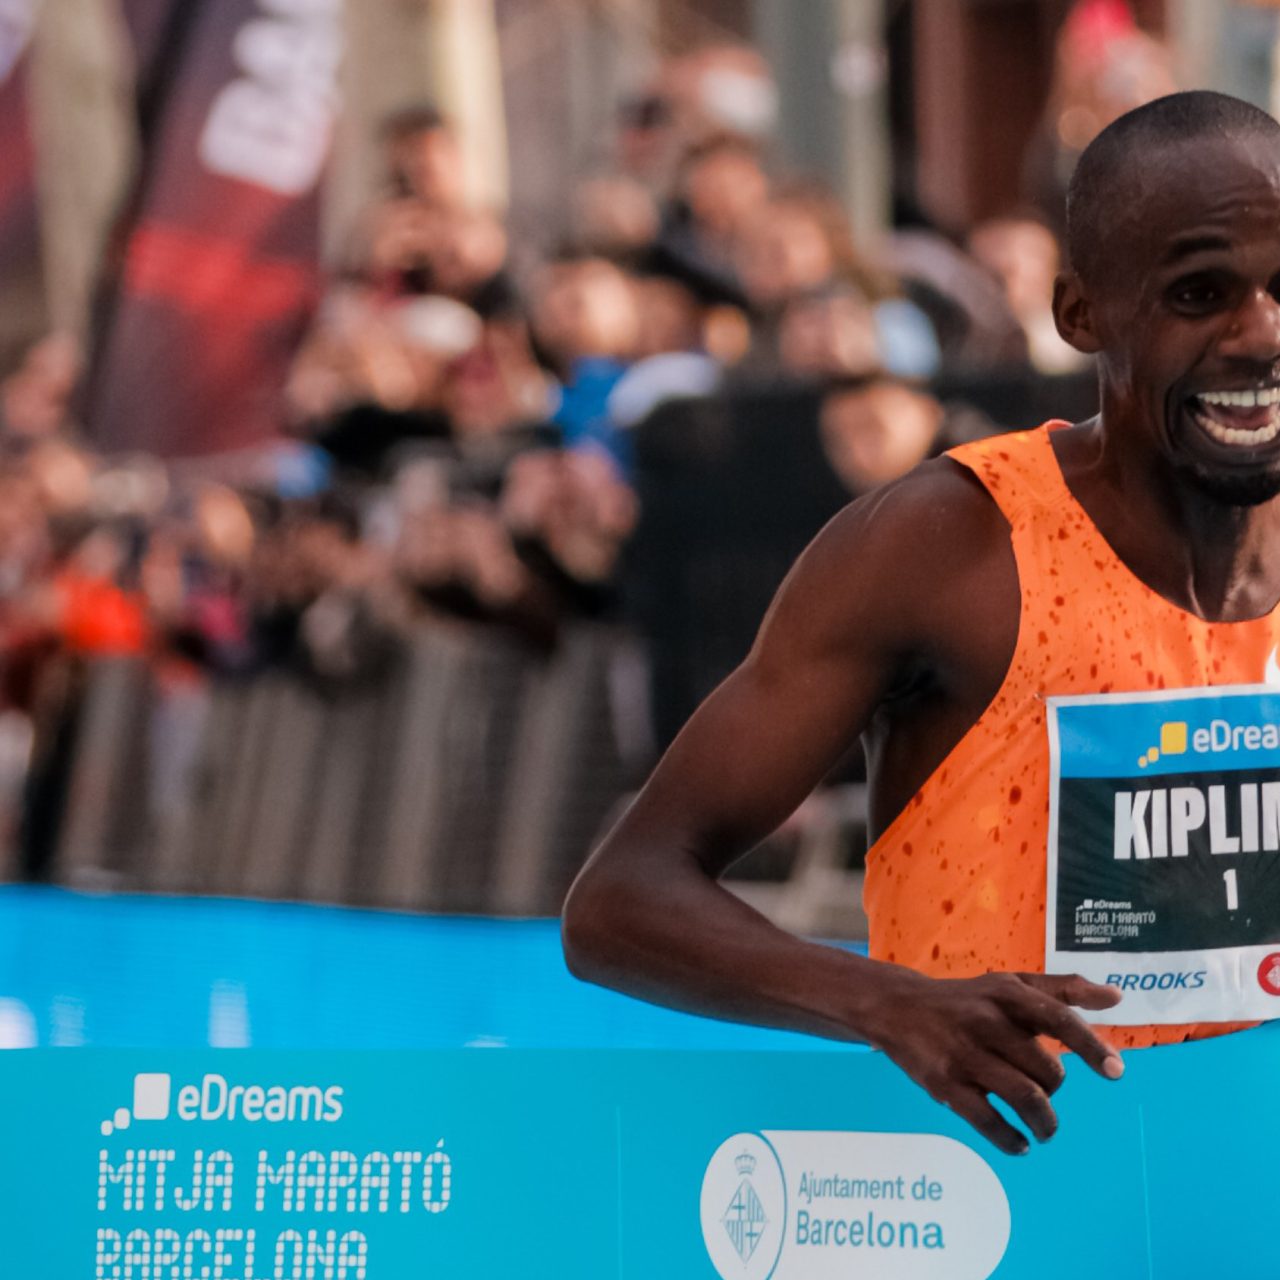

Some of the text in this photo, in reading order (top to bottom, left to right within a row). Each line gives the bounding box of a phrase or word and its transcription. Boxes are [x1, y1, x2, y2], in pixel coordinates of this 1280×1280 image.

[1223, 868, 1238, 910] 1
[177, 1073, 344, 1122] eDreams
[97, 1138, 452, 1213] MITJA MARATÓ
[798, 1171, 943, 1204] Ajuntament de
[796, 1210, 946, 1249] Barcelona
